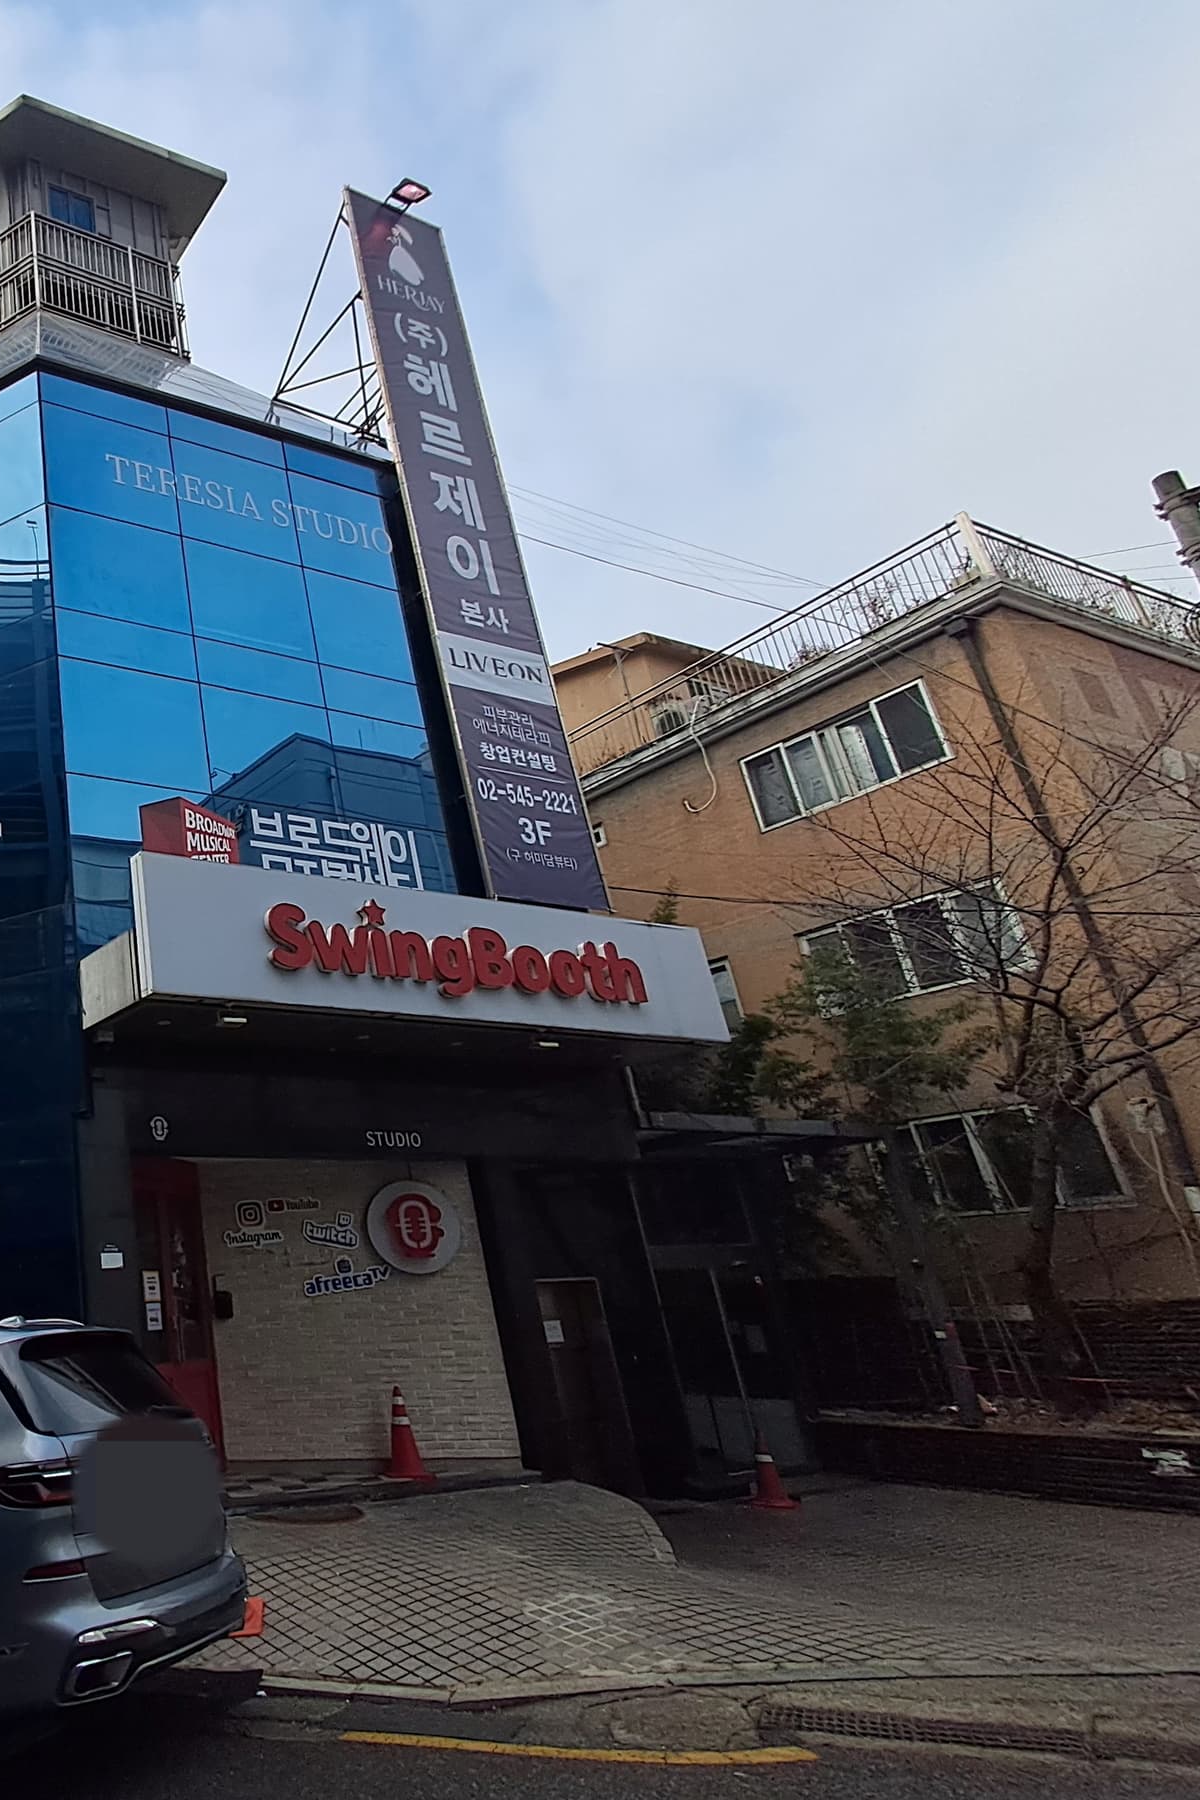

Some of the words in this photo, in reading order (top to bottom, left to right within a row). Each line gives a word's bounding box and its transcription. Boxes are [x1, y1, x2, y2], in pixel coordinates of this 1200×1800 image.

[105, 453, 264, 521] TERESIA
[272, 498, 393, 555] STUDIO
[460, 598, 509, 634] 본사
[448, 647, 544, 685] LIVEON
[482, 705, 535, 729] 피부관리
[472, 717, 552, 748] 에너지테라피
[480, 741, 557, 773] 창업컨설팅
[477, 777, 578, 816] 02-545-2221
[186, 831, 232, 853] MUSICAL
[518, 817, 552, 846] 3F
[263, 899, 649, 1006] SwingBooth
[365, 1130, 422, 1148] STUDIO
[224, 1231, 283, 1247] Instagram
[305, 1222, 357, 1246] twitch
[305, 1266, 390, 1295] afreecaTV
